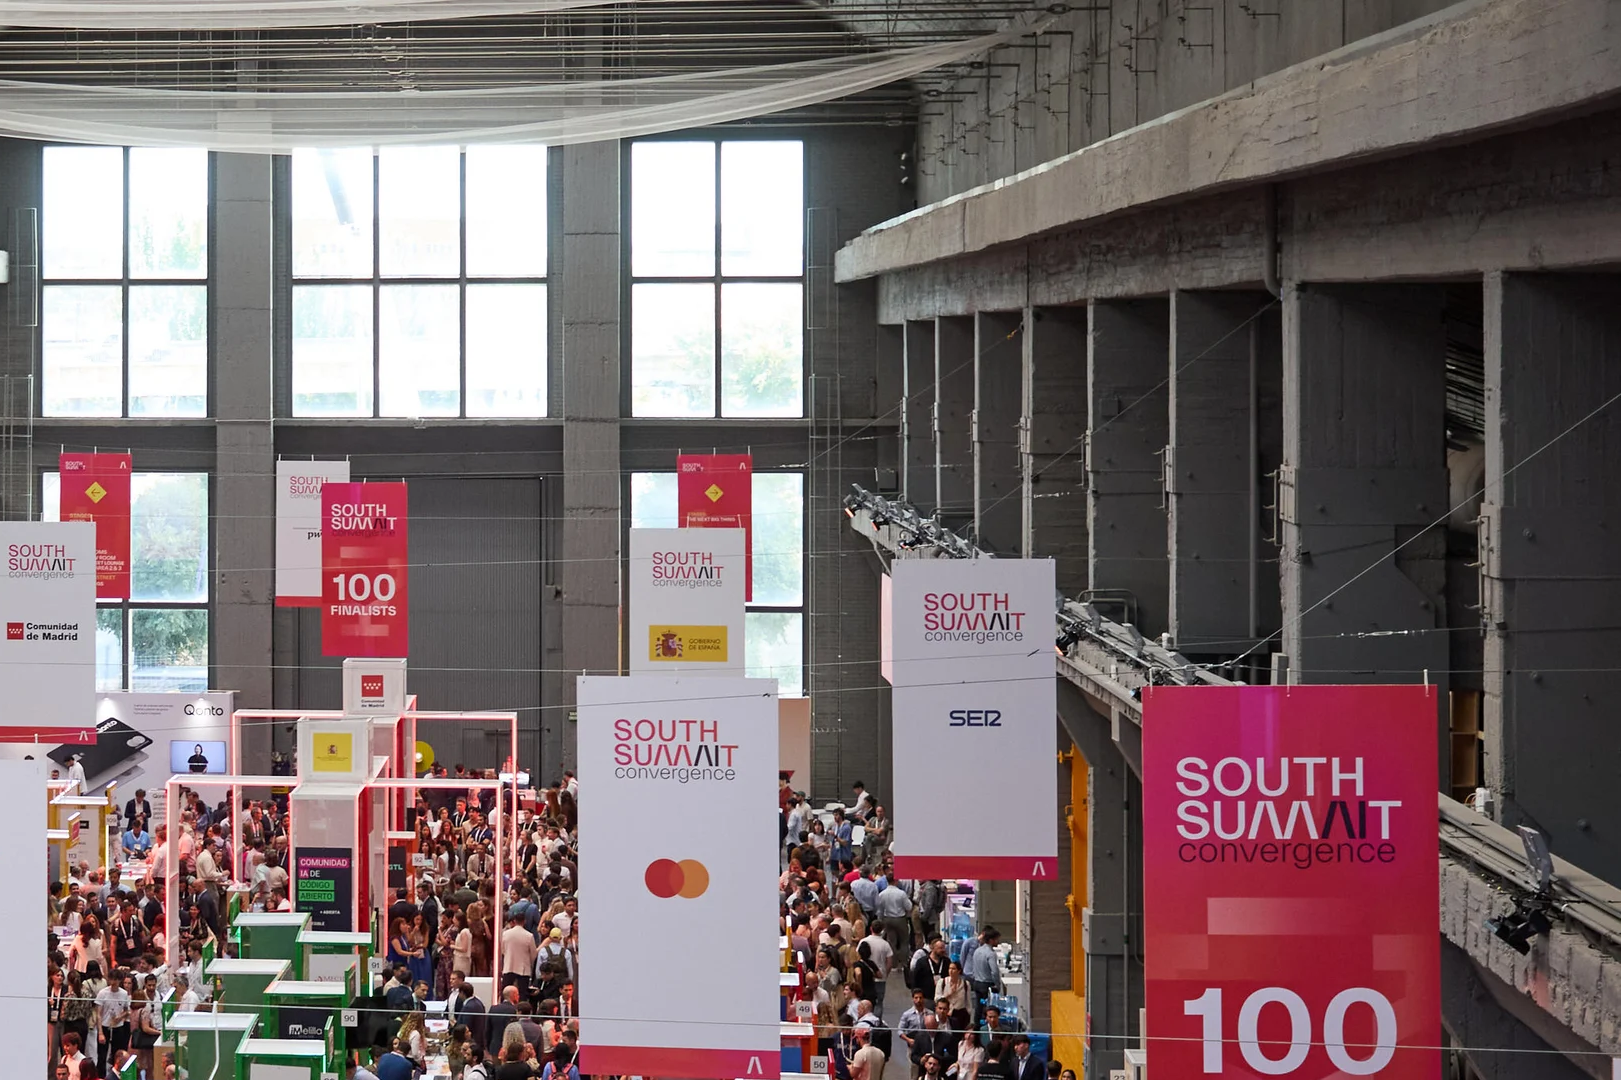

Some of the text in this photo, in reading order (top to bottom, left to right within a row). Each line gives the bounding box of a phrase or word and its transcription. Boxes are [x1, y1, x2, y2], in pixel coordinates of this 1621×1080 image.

[331, 503, 386, 517] SOUTH
[332, 530, 396, 538] convergence
[9, 544, 65, 558] SOUTH
[9, 558, 76, 571] SUMMIT
[652, 552, 712, 565] SOUTH
[9, 570, 75, 580] convergence
[652, 566, 724, 579] SUMMIT
[333, 573, 396, 601] 100
[653, 579, 722, 589] convergence
[924, 593, 1009, 612] SOUTH
[330, 605, 397, 616] FINALISTS
[26, 622, 78, 630] Comunidad
[924, 613, 1025, 631] SUMMIT
[924, 630, 1023, 644] convergence
[184, 704, 224, 716] Qonto
[950, 710, 1002, 727] SER
[614, 719, 718, 742] SOUTH
[614, 744, 739, 767] SUMMIT
[615, 766, 736, 783] convergence
[1176, 757, 1364, 796] SOUTH
[1176, 801, 1402, 840] SUMMIT
[1178, 838, 1396, 869] convergence
[300, 858, 348, 867] COMUNIDAD
[300, 870, 320, 878] IA DE
[300, 880, 330, 889] CÓDIGO
[799, 1005, 810, 1013] 49
[1184, 987, 1397, 1076] 100
[814, 1061, 825, 1069] 50
